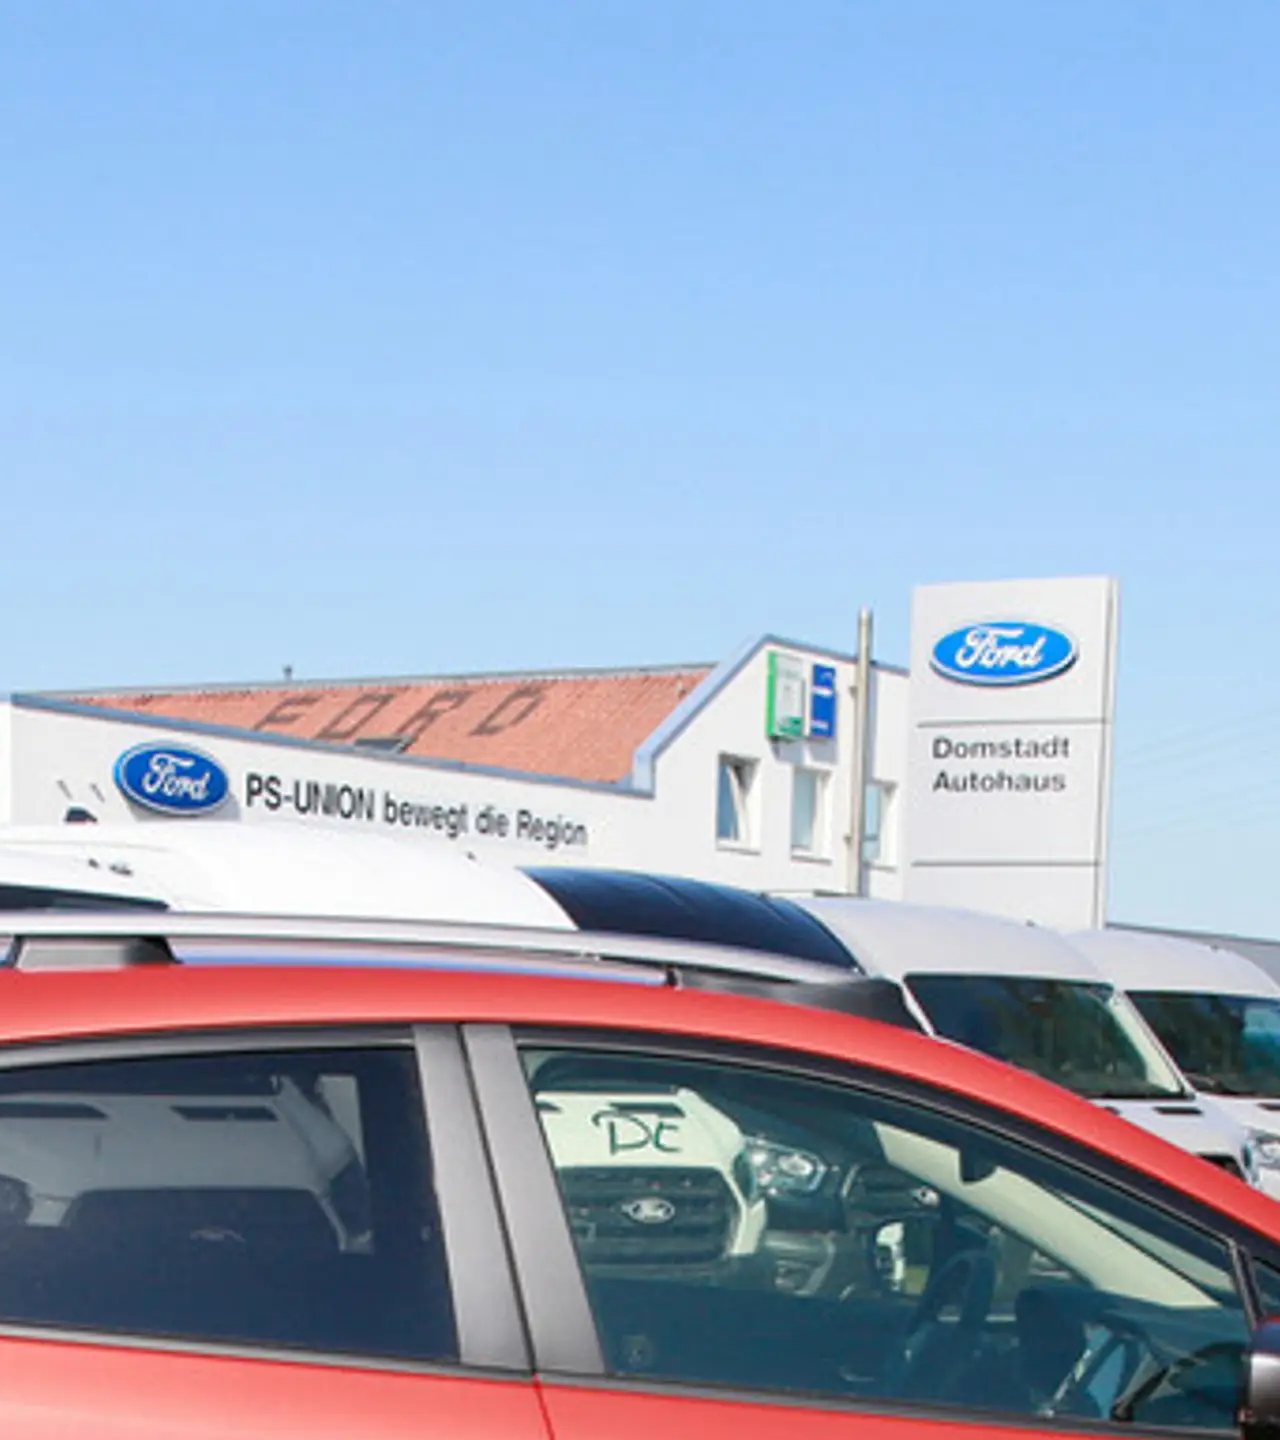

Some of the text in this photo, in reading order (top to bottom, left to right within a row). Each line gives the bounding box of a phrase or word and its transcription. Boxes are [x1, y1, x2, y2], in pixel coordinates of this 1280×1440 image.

[954, 627, 1048, 669] Ford
[253, 688, 548, 752] FORD
[931, 735, 1071, 760] Domstadt
[141, 752, 212, 800] Ford
[931, 770, 1068, 793] Autohaus
[246, 772, 589, 850] PS-UNION bewegt die Region
